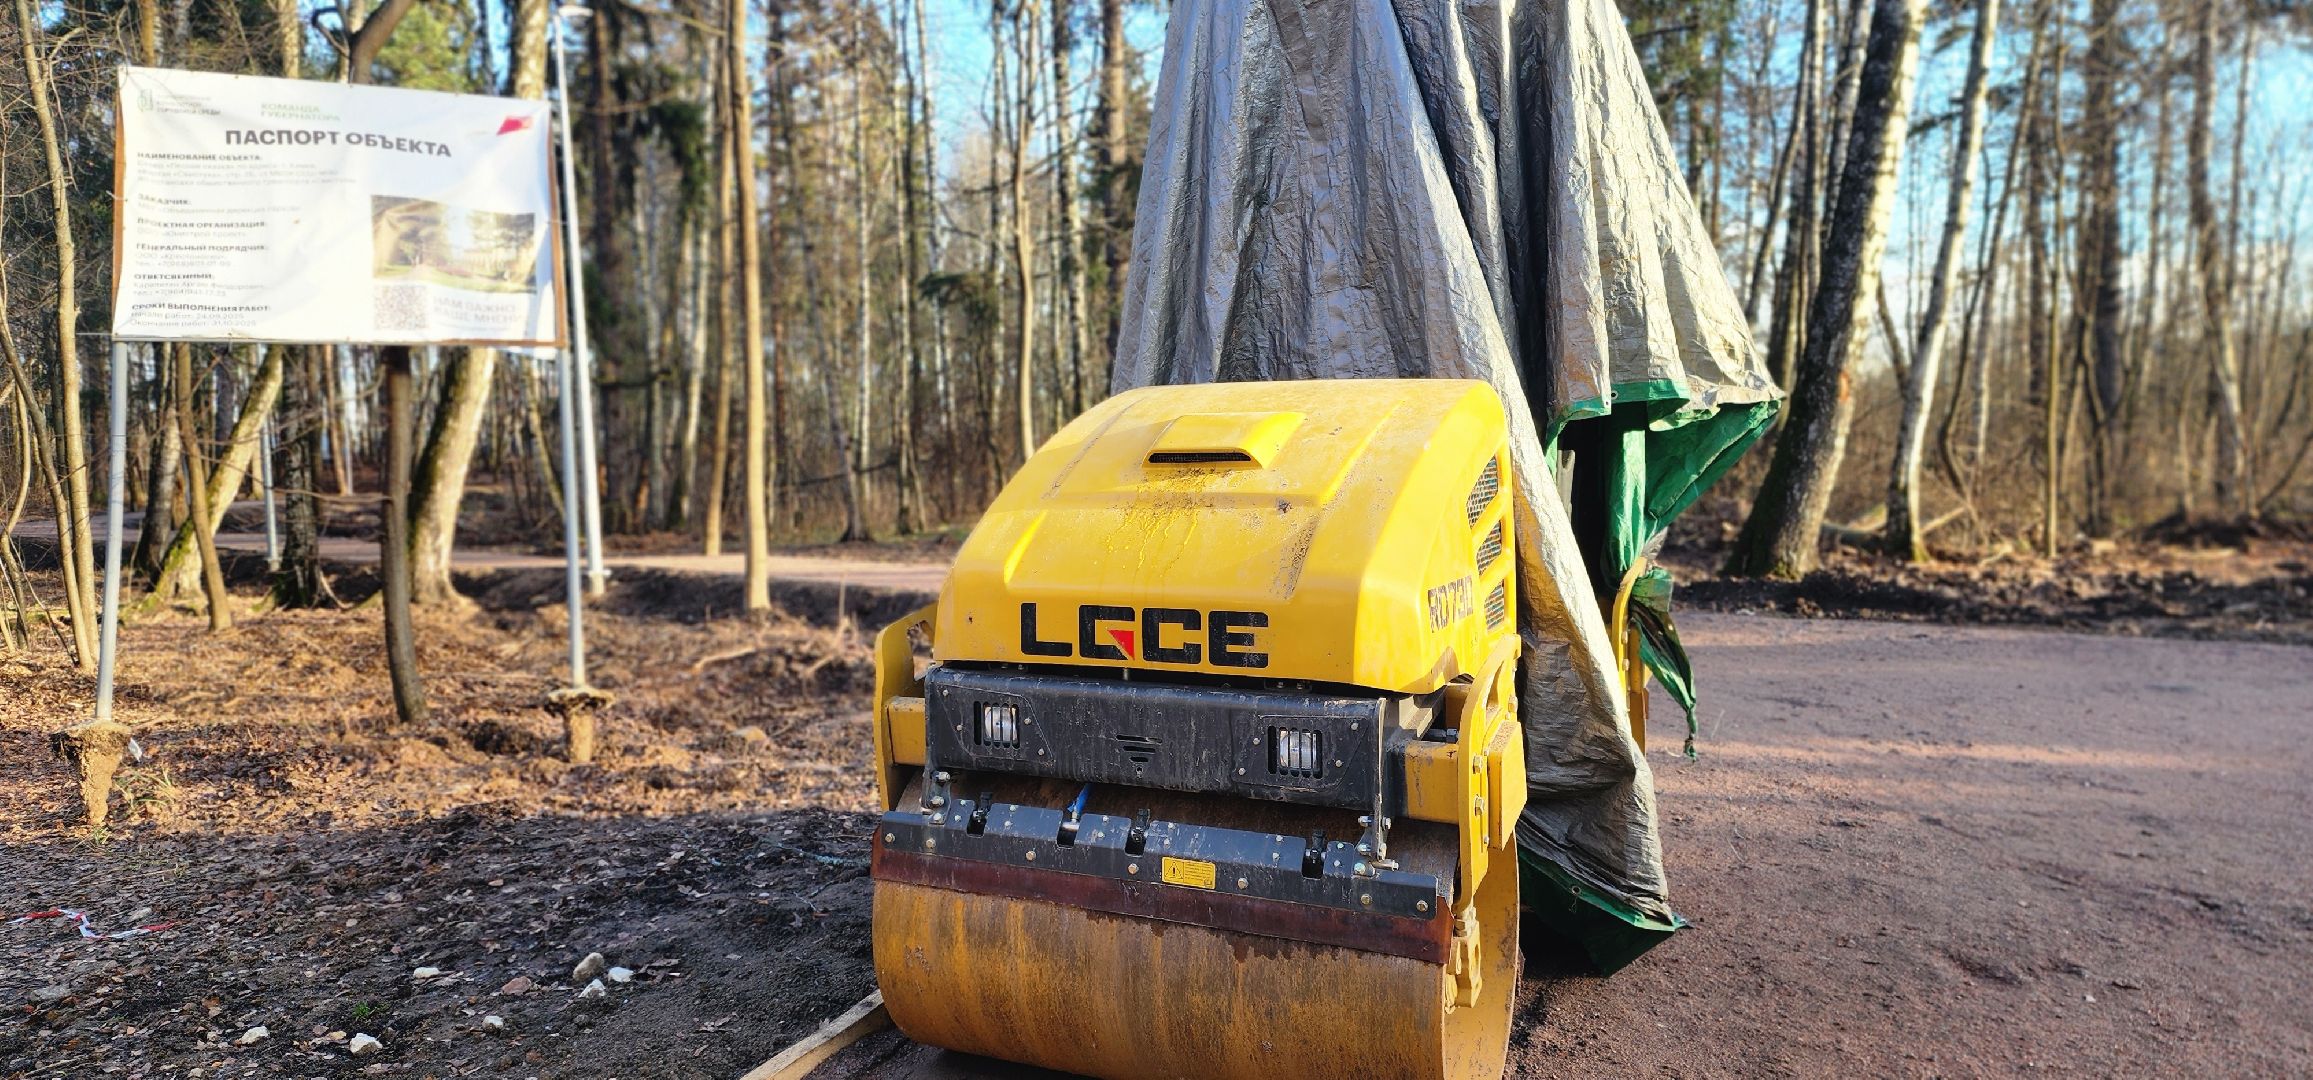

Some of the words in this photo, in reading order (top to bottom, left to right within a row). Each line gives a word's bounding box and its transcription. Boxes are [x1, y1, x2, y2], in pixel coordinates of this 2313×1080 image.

[224, 128, 341, 147] ПАСПОРТ
[345, 131, 452, 158] ОБЪЕКТА
[136, 152, 216, 161] НАИМЕНОВАНИЕ
[138, 193, 192, 205] ЗАКАЗЧИК:
[137, 217, 195, 228] ПРОЕКТНАЯ
[136, 242, 206, 251] ГЕНЕРАЛЬНЫЙ
[132, 302, 165, 311] СРОКИ
[167, 302, 238, 312] ВЫПОЛНЕНИЯ
